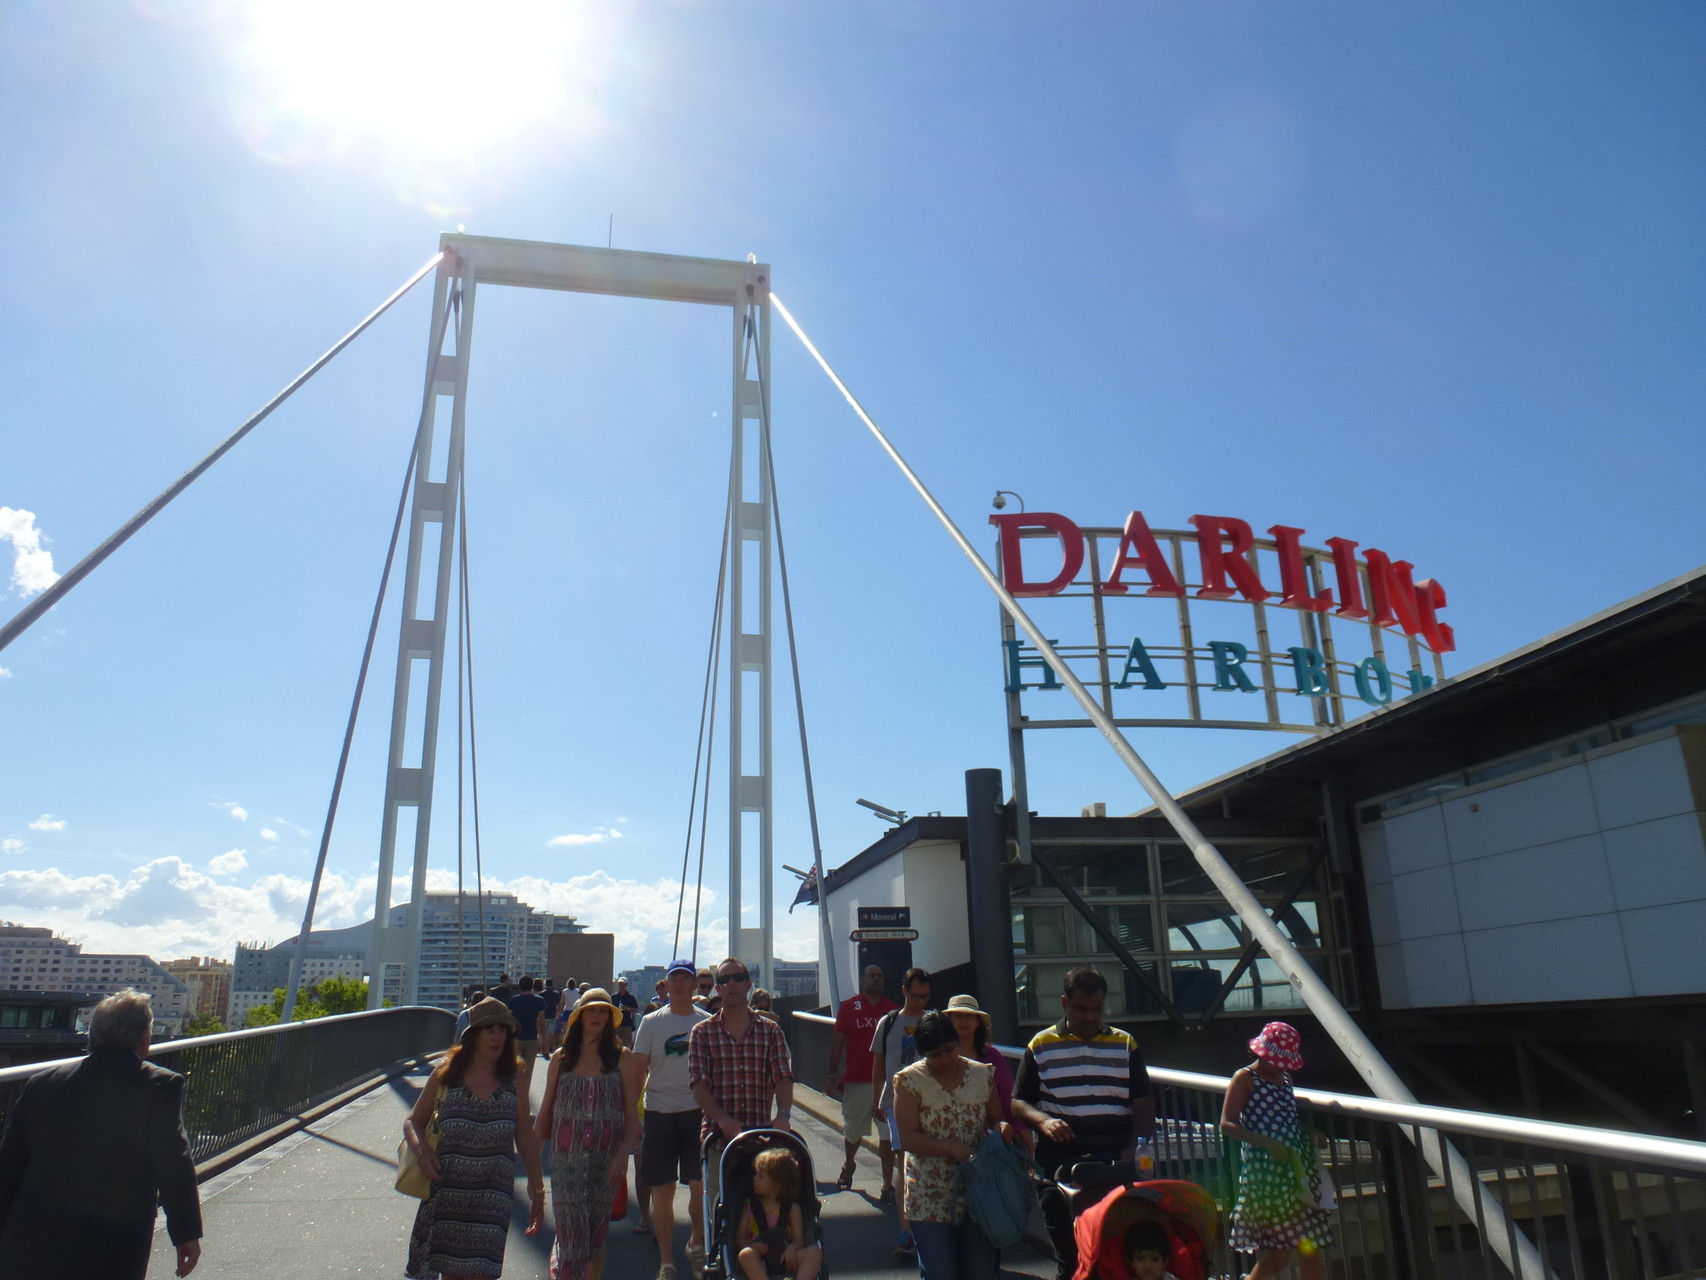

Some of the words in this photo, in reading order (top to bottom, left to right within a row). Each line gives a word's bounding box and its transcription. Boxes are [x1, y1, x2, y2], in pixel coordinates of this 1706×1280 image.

[989, 511, 1456, 654] DARLING
[871, 913, 897, 921] Monorail
[853, 1000, 863, 1011] 3
